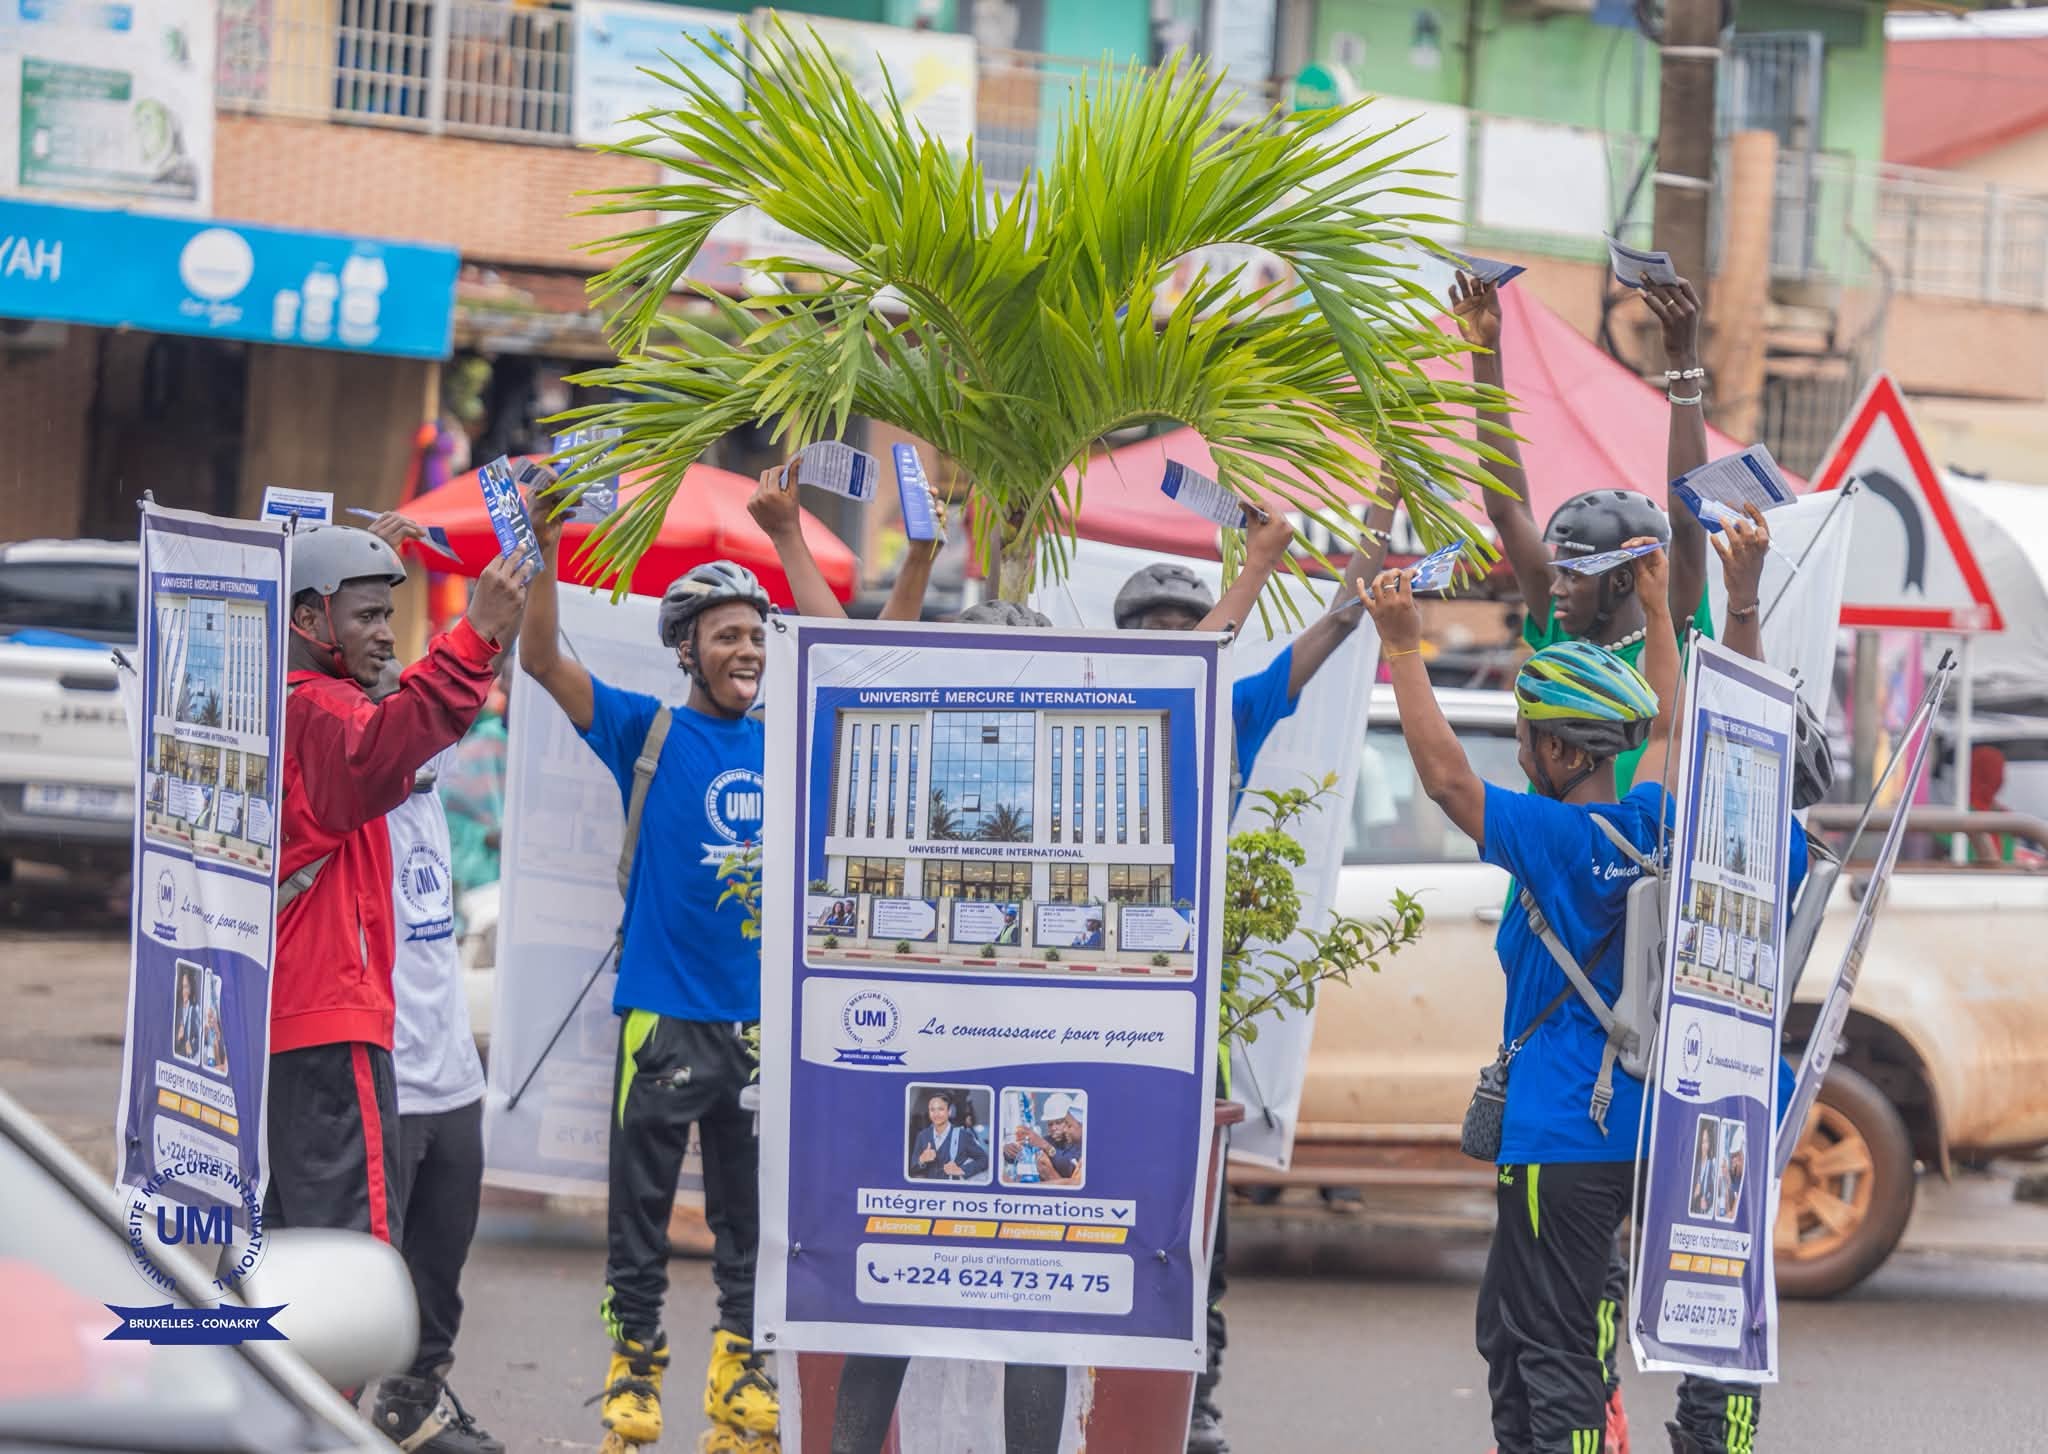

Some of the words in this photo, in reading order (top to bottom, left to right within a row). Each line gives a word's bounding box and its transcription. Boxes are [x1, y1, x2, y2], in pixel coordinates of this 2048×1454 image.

[860, 689, 939, 703] UNIVERSITÉ
[945, 691, 1014, 703] MERCURE
[1020, 691, 1136, 704] INTERNATIONAL
[726, 791, 761, 821] UMI
[909, 844, 959, 855] UNIVERSITÉ
[962, 847, 1003, 856] MERCURE
[1006, 848, 1084, 858] INTERNATIONAL
[849, 992, 881, 1006] MERCURE
[855, 1009, 886, 1027] UMI
[918, 1016, 946, 1035] La
[951, 1023, 1056, 1040] connaissance
[1060, 1026, 1100, 1044] pour
[1105, 1029, 1167, 1048] gagner
[158, 1066, 185, 1088] Intégrer
[186, 1079, 199, 1093] nos
[199, 1080, 234, 1108] formations
[865, 1193, 946, 1214] Intégrer
[952, 1199, 987, 1213] nos
[993, 1199, 1104, 1218] formations
[953, 1223, 977, 1234] BTS
[934, 1252, 958, 1263] Pour
[962, 1253, 984, 1265] plus
[894, 1266, 951, 1285] +224
[959, 1269, 1003, 1287] 624
[1011, 1271, 1039, 1289] 73
[1046, 1273, 1074, 1291] 74
[1081, 1274, 1110, 1293] 75
[960, 1289, 1051, 1302] www.umi-gn.com
[1691, 1304, 1706, 1323] 624
[1707, 1306, 1717, 1325] 73
